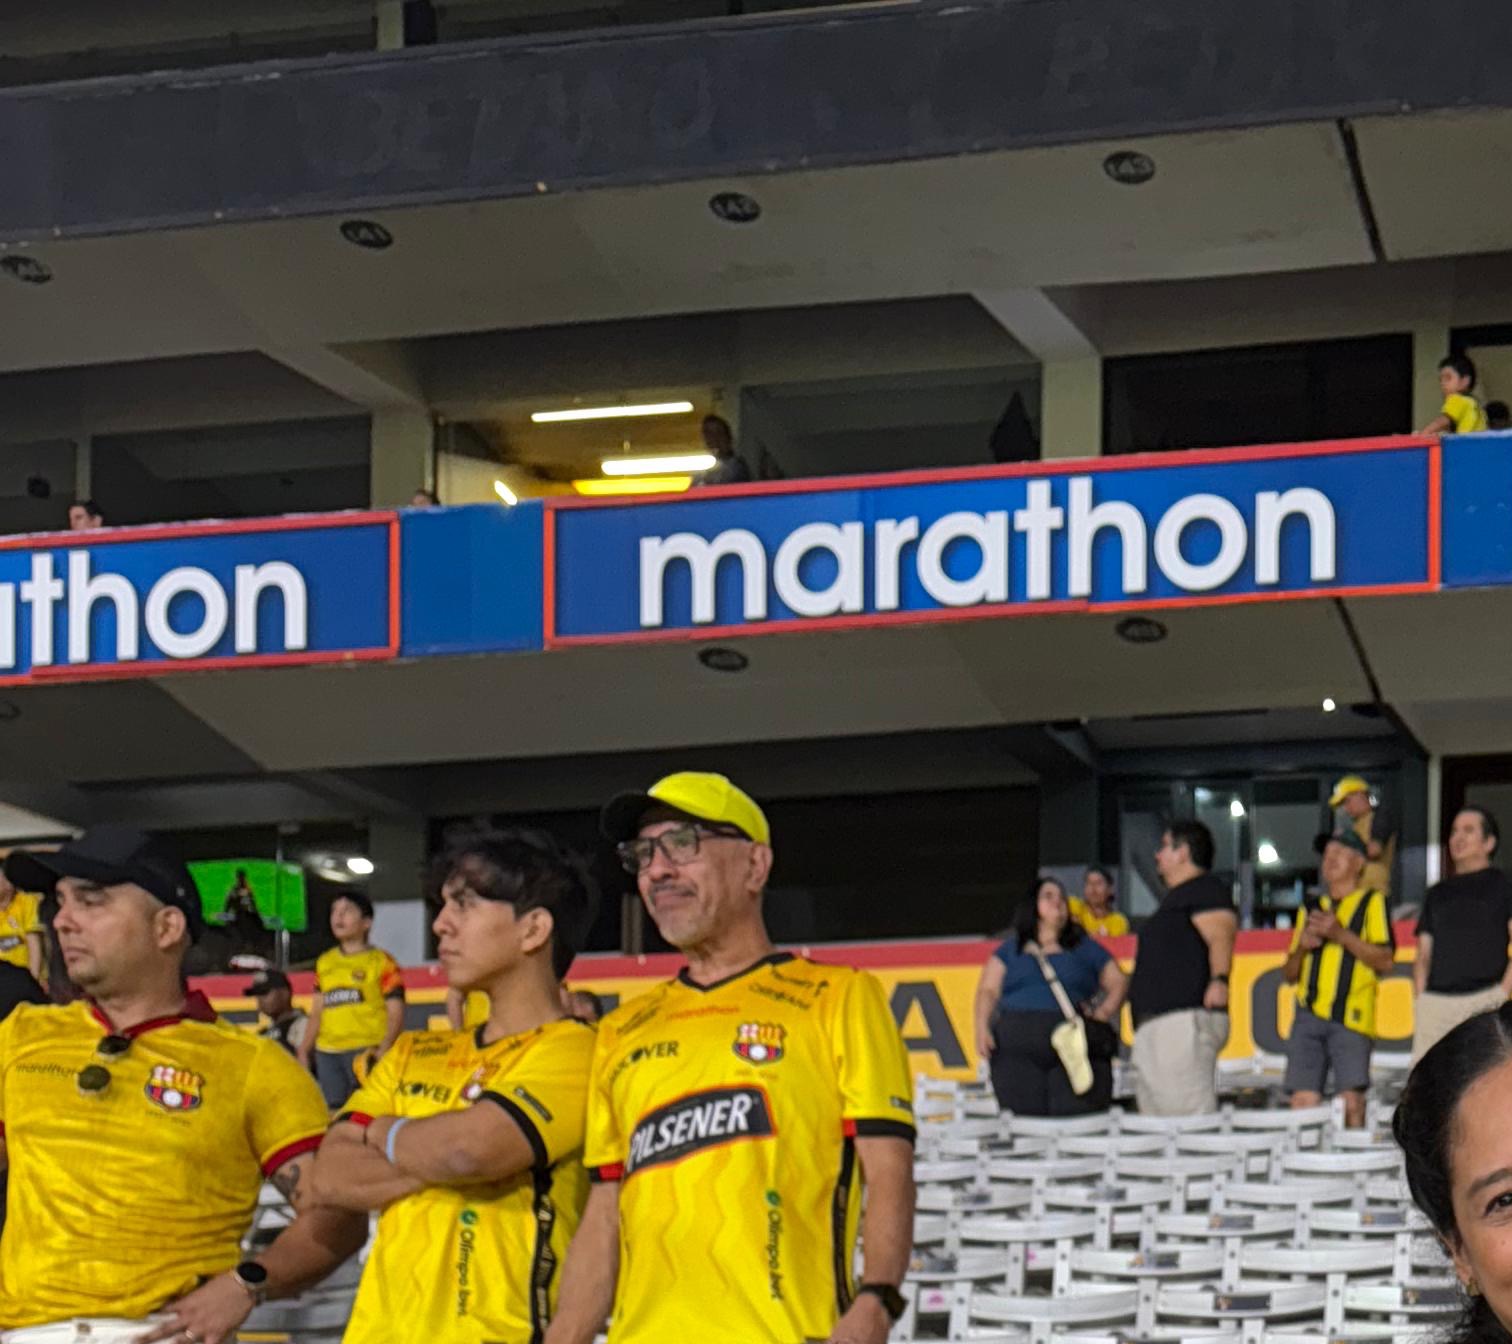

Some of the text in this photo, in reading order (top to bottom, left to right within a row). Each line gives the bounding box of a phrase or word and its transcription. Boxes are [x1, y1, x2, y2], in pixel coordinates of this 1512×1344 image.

[0, 549, 307, 669] thon
[639, 475, 1337, 629] marathon
[626, 1092, 753, 1173] PILSENER
